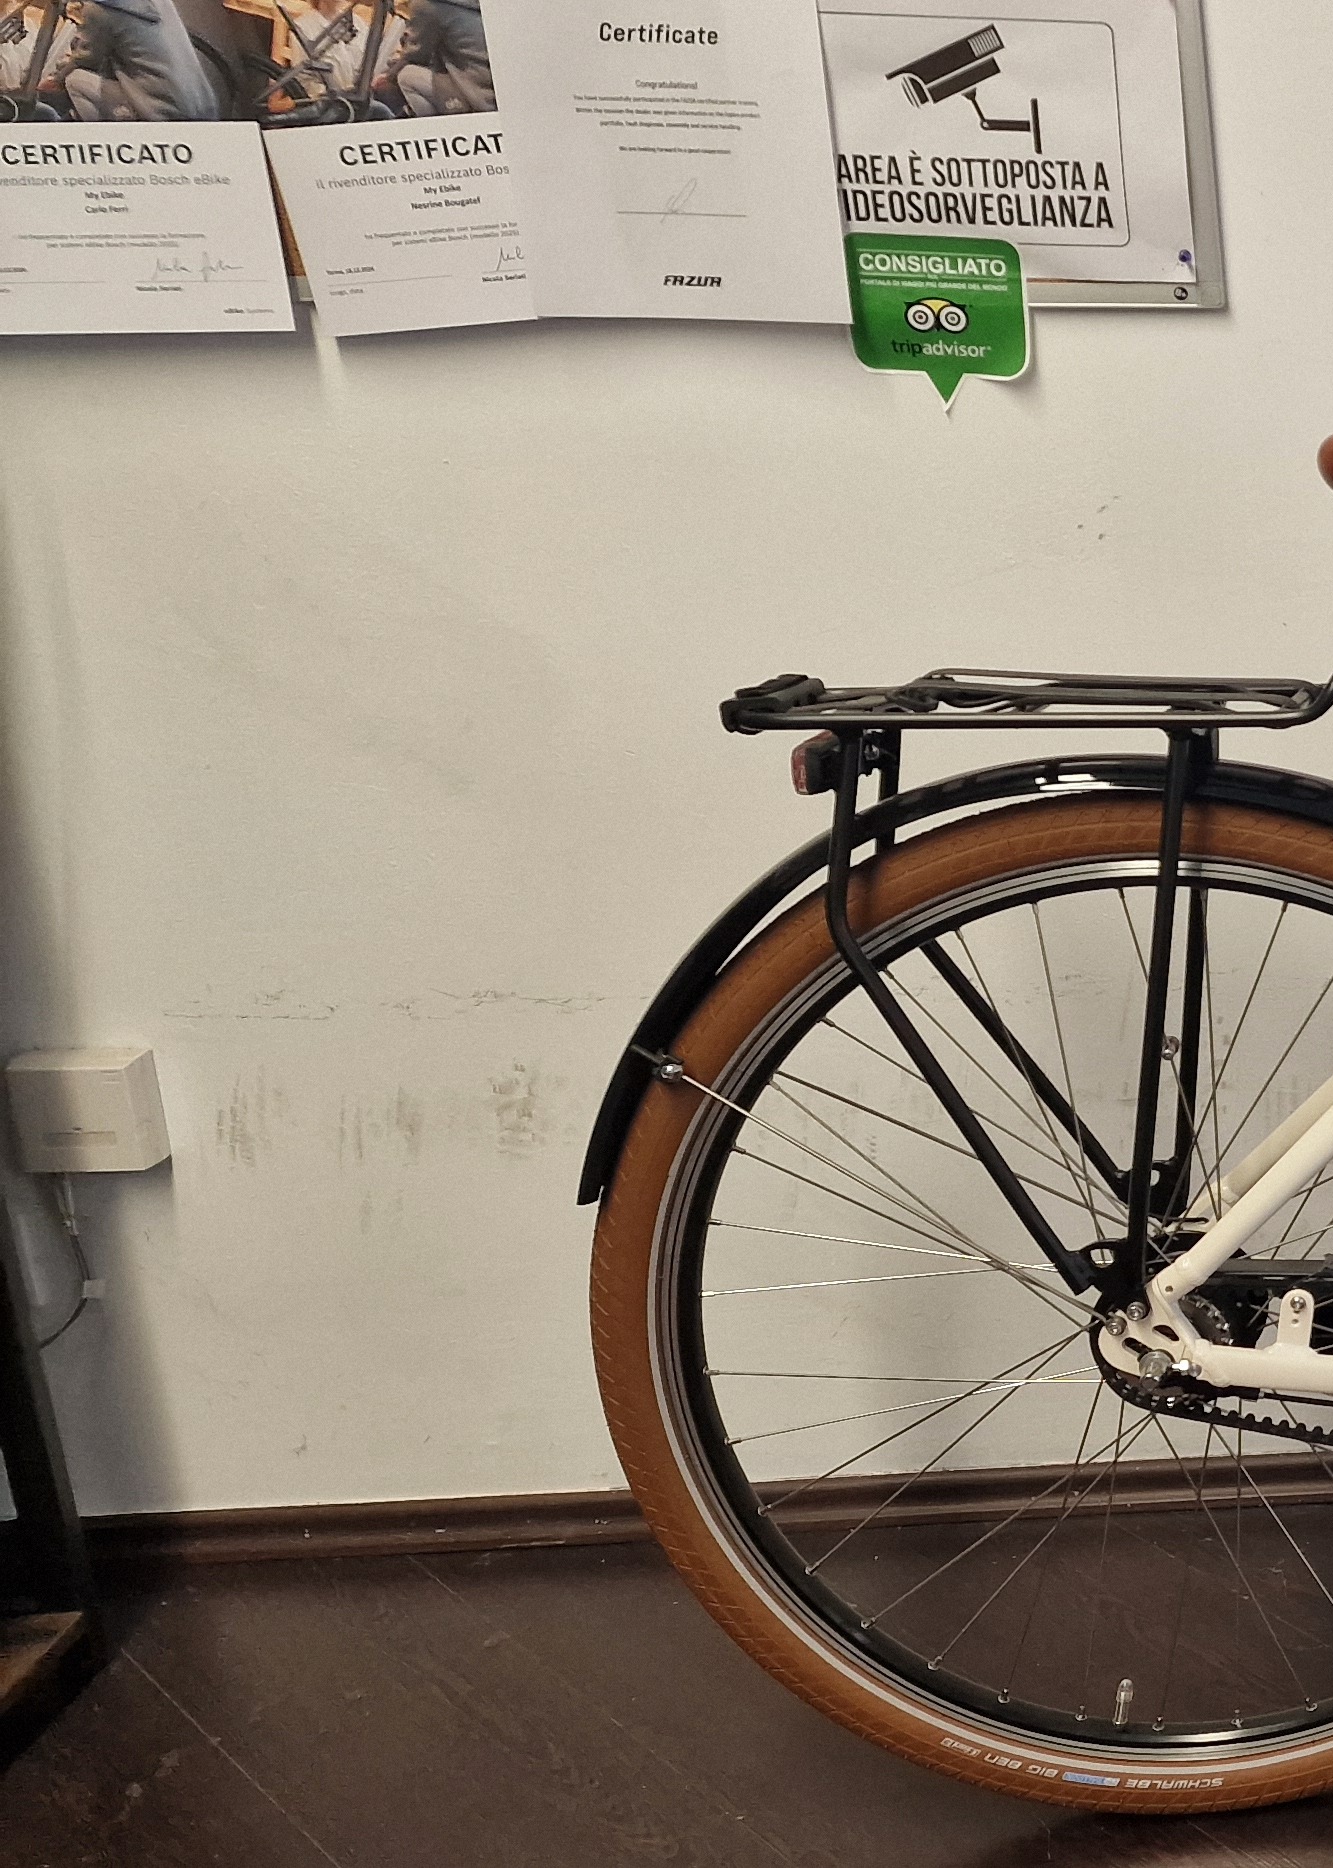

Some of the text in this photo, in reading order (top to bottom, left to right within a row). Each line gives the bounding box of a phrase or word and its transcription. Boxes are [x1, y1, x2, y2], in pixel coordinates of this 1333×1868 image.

[599, 22, 719, 45] Certificate
[2, 143, 193, 165] CERTIFICATO
[339, 133, 504, 166] CERTIFICAT
[328, 174, 397, 189] rivenditore
[401, 167, 482, 184] specializzato
[837, 149, 1110, 192] AREA È SOTTOPOSTA A
[859, 253, 1007, 277] CONSIGLIATO
[892, 339, 986, 358] tripadvisor
[1025, 1765, 1058, 1778] BIG
[1125, 1777, 1224, 1789] SCHWALBE
